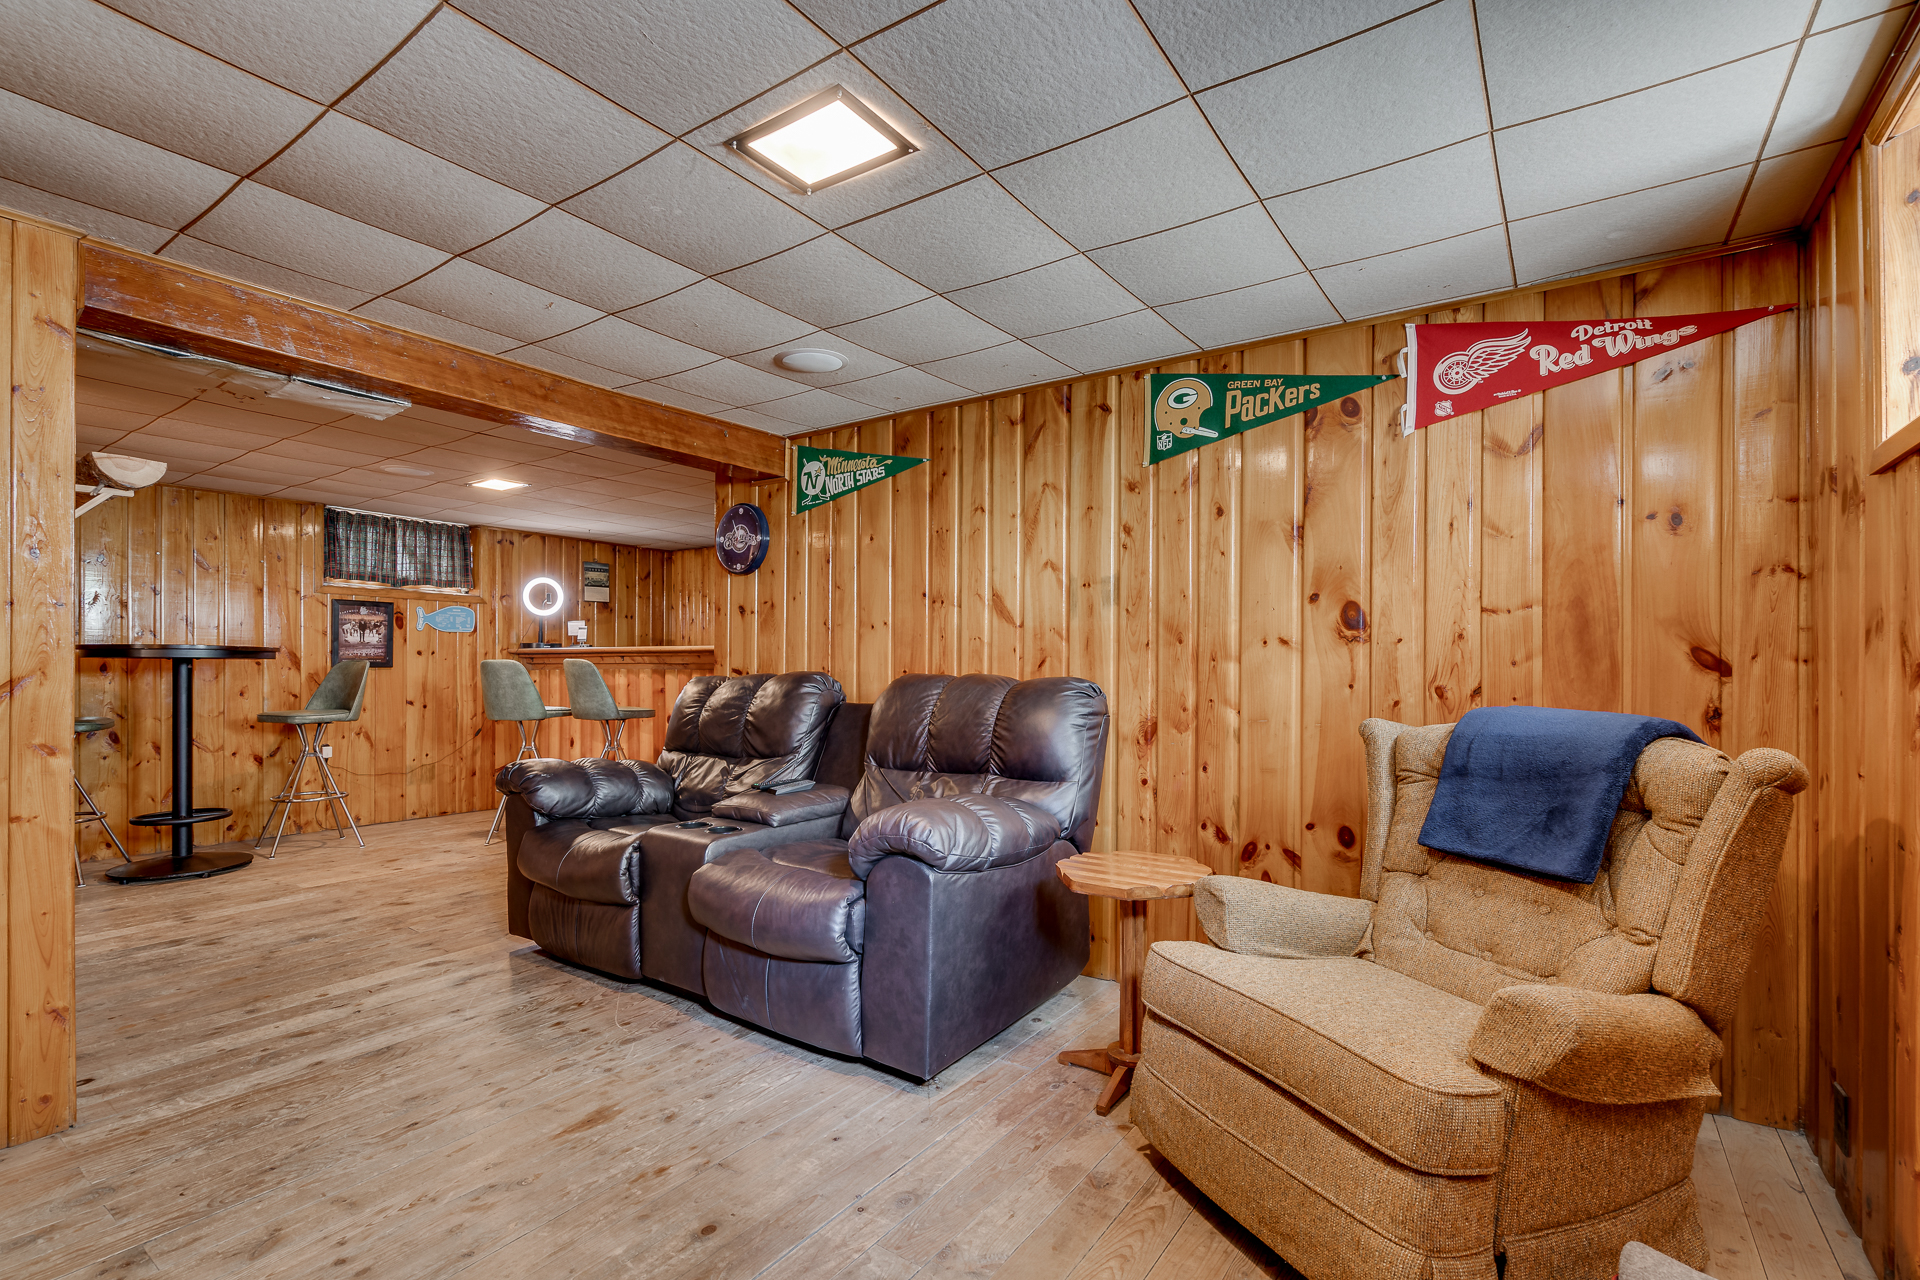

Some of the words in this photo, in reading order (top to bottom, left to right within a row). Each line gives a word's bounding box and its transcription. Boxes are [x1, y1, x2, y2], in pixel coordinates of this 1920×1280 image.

[1570, 319, 1653, 342] Detroit
[1529, 344, 1594, 376] Red
[1591, 325, 1698, 358] Wings
[1227, 380, 1261, 389] GREEN
[1264, 378, 1284, 387] BAY
[1168, 387, 1198, 409] G
[819, 455, 893, 475] Minnesota
[825, 473, 855, 497] NORTH
[856, 466, 886, 486] STARS
